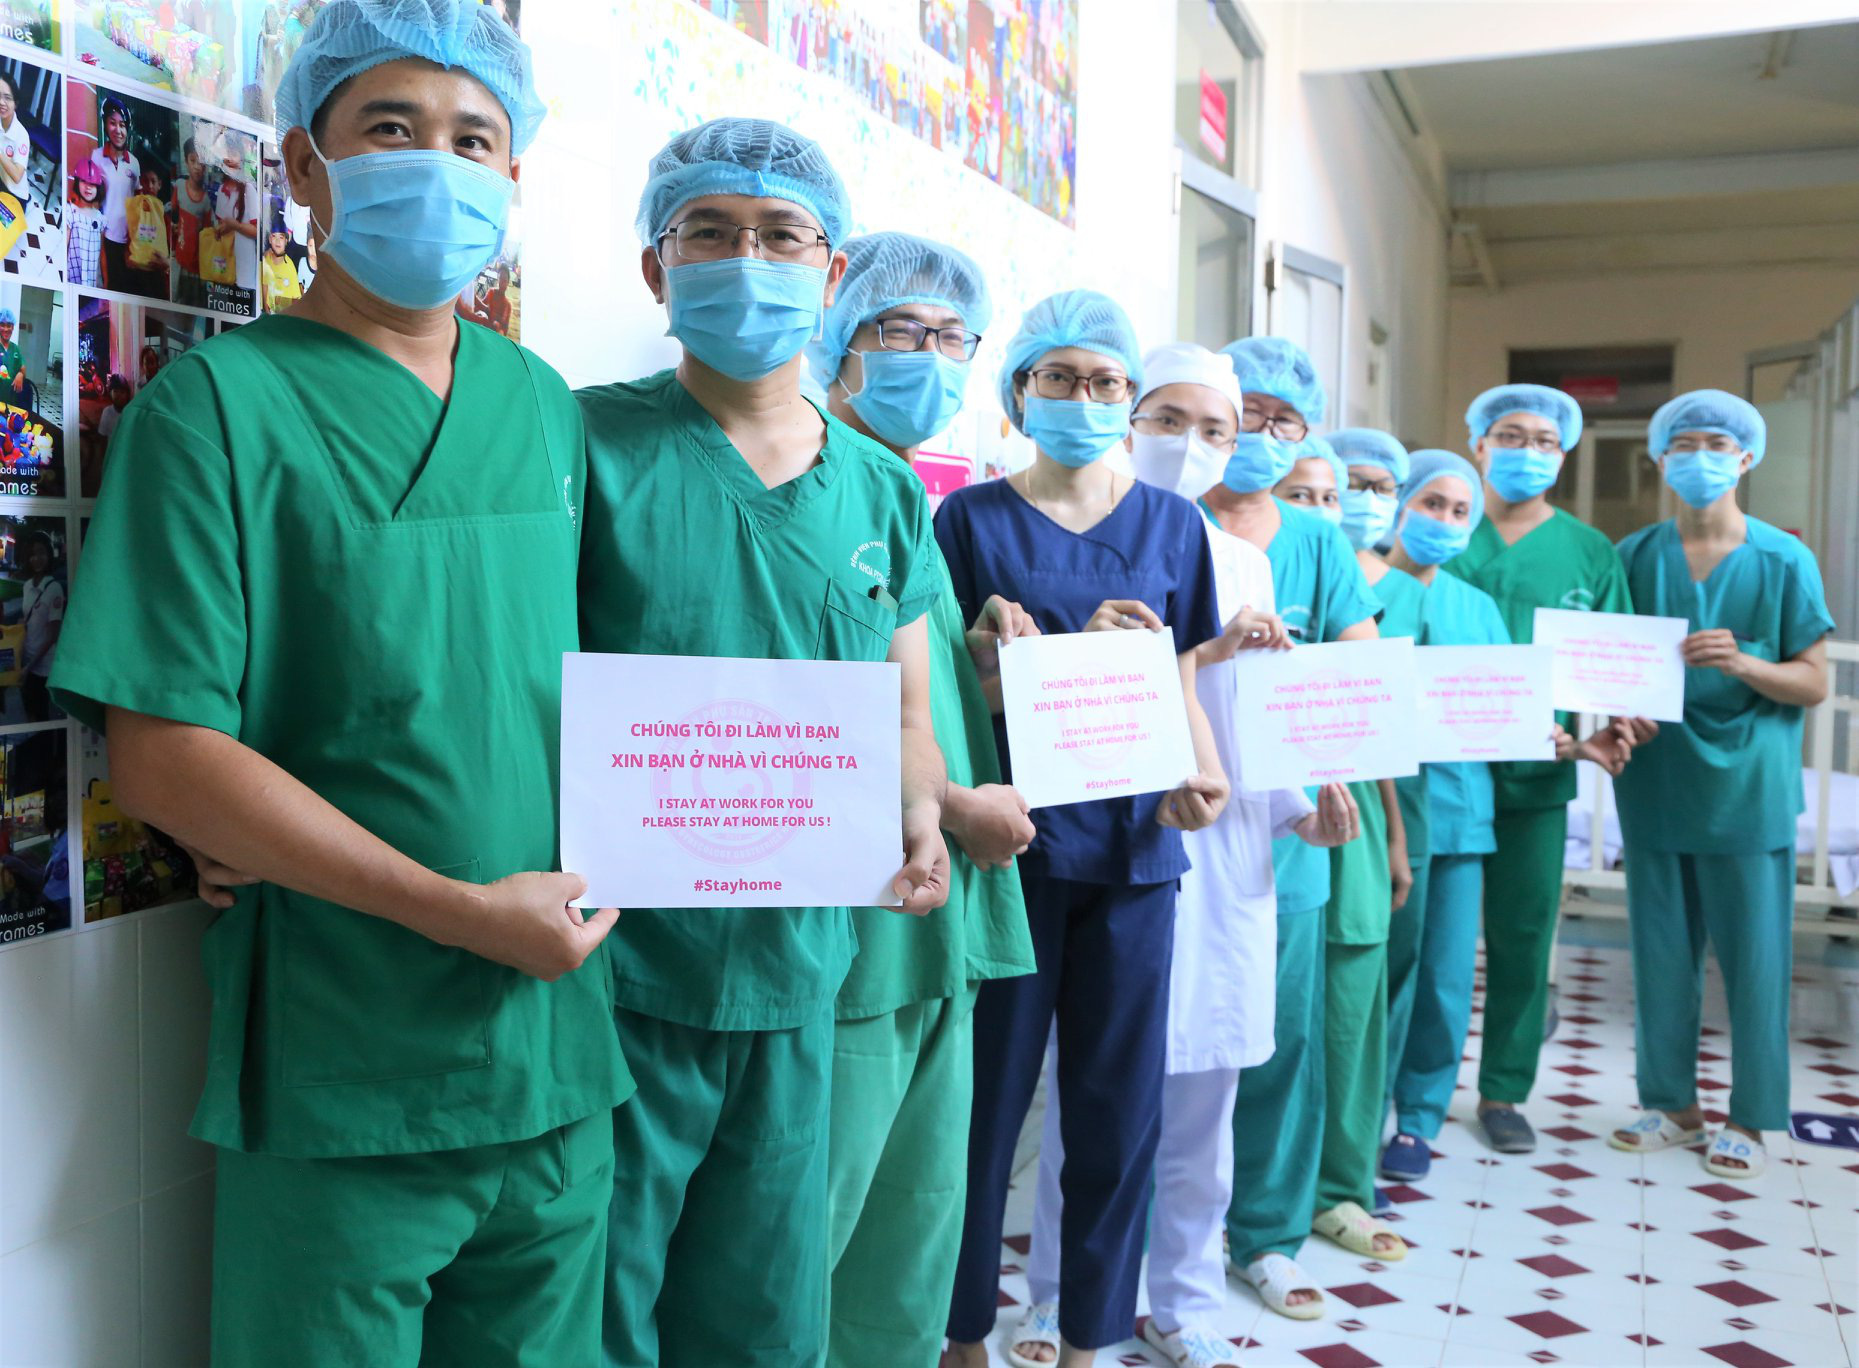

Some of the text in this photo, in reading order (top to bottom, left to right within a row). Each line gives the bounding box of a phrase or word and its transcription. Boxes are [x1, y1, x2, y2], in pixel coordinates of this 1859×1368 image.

[214, 284, 251, 299] Made with
[208, 294, 250, 316] Frames
[20, 466, 39, 476] with
[1034, 702, 1051, 713] XIN
[631, 720, 840, 742] CHÚNG TÔI ĐI LÀM VÌ BẠN
[611, 749, 858, 772] XIN BẠN Ở NHÀ VÌ CHÚNG TA
[1086, 778, 1132, 789] #Stayhome
[659, 799, 814, 809] I STAY AT WORK FOR YOU
[642, 817, 686, 827] PLEASE
[689, 817, 720, 827] STAY
[723, 817, 739, 827] AT
[742, 817, 779, 827] HOME
[781, 817, 806, 827] FOR
[808, 817, 825, 827] US
[694, 878, 783, 895] #Stayhome
[0, 907, 46, 923] Made with
